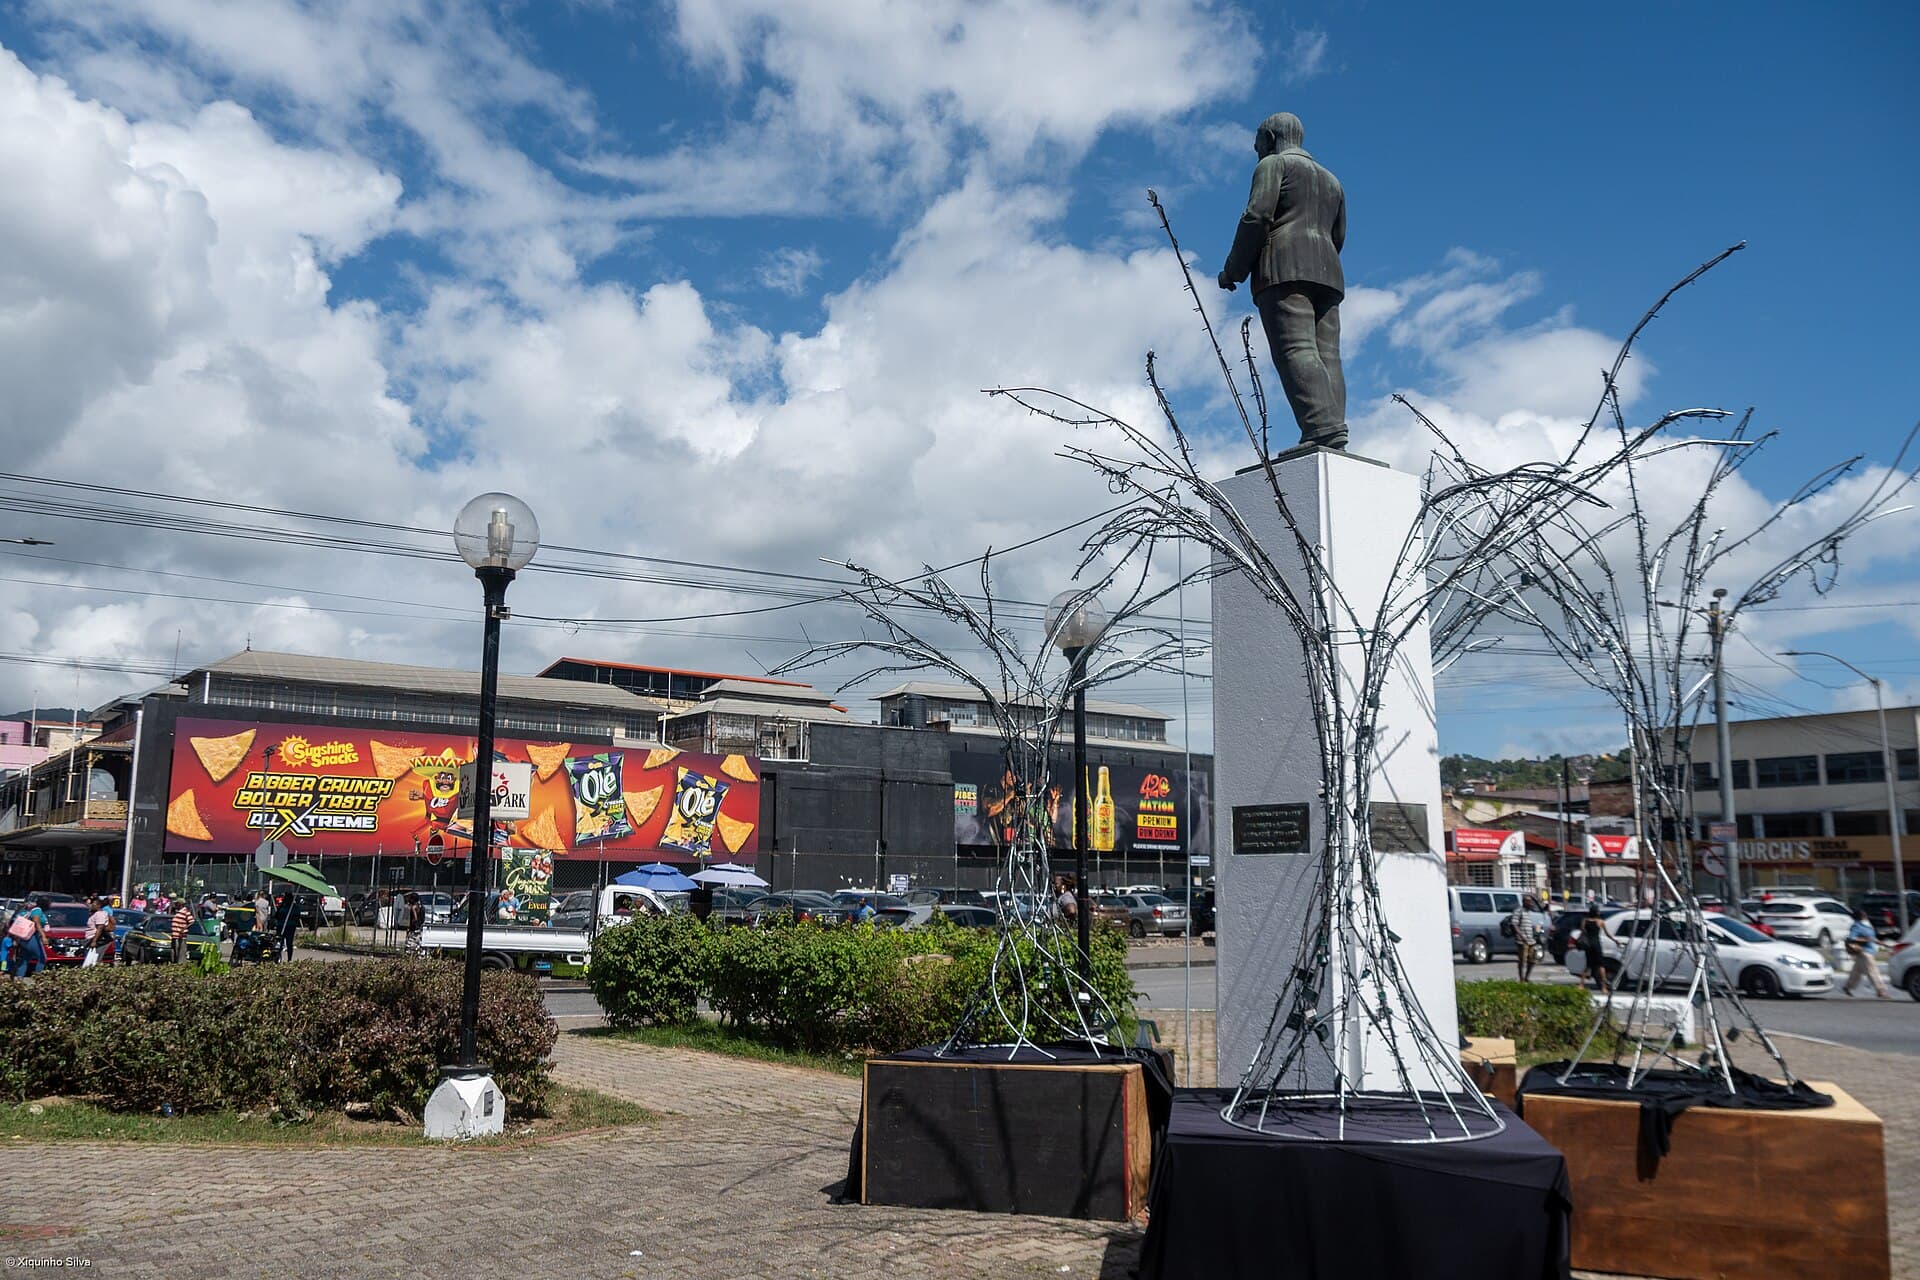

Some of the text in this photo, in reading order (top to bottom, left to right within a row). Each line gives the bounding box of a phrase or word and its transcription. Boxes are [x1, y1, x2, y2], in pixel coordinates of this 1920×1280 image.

[294, 741, 354, 759] Sunshine
[311, 752, 359, 768] Snacks
[247, 775, 392, 794] BIGGER CRUNCH
[581, 766, 617, 805] Olé
[236, 791, 378, 810] BOLDER TASTE
[682, 787, 716, 818] Olé
[1139, 799, 1175, 812] NATION
[1142, 816, 1172, 827] PREMIUM
[1738, 841, 1810, 860] URCH'S
